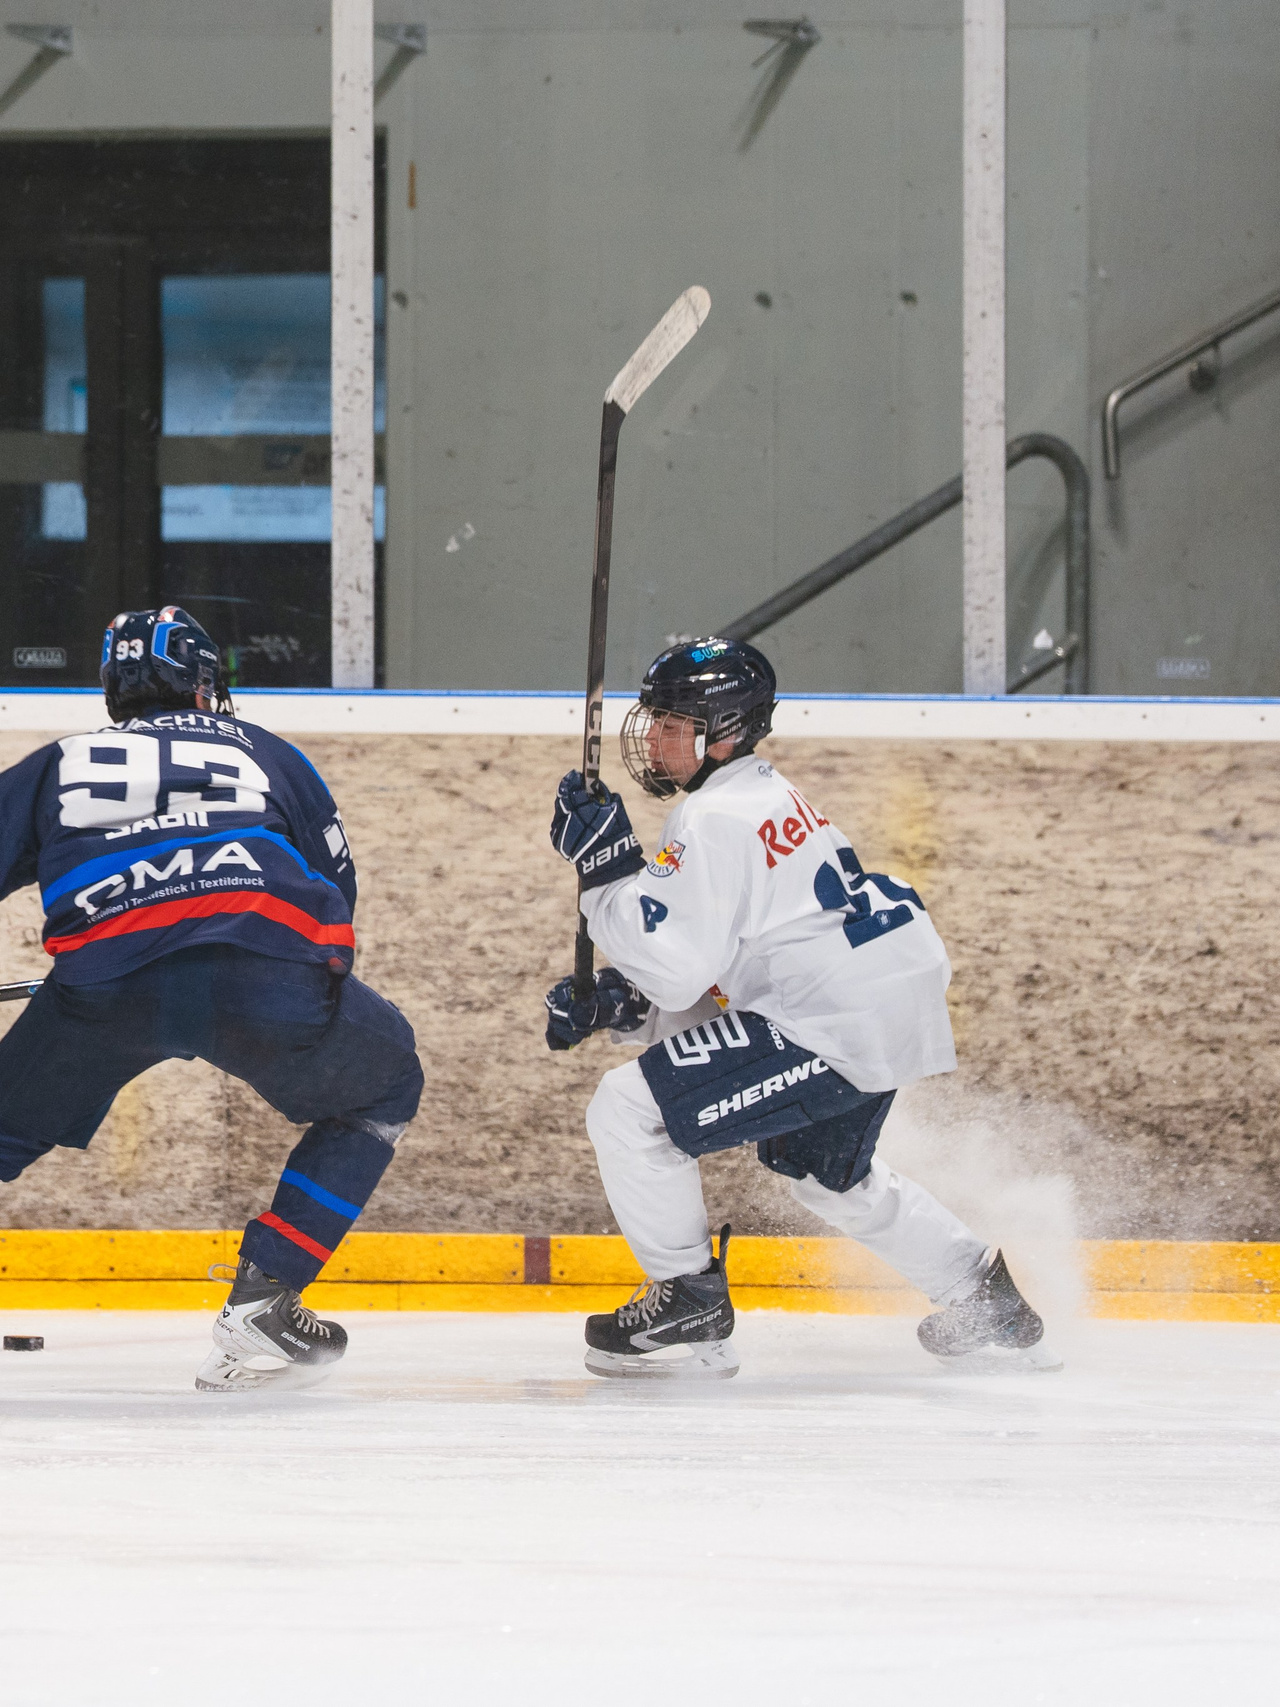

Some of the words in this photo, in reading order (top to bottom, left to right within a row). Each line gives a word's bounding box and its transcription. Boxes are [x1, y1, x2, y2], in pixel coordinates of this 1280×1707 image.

[115, 638, 144, 661] 93
[704, 680, 739, 696] BAUER
[58, 733, 271, 828] 93
[581, 833, 640, 875] AUER
[74, 841, 263, 916] CMA
[198, 876, 265, 890] Textildruck
[681, 1308, 722, 1332] BAUER
[280, 1331, 311, 1351] BAUER
